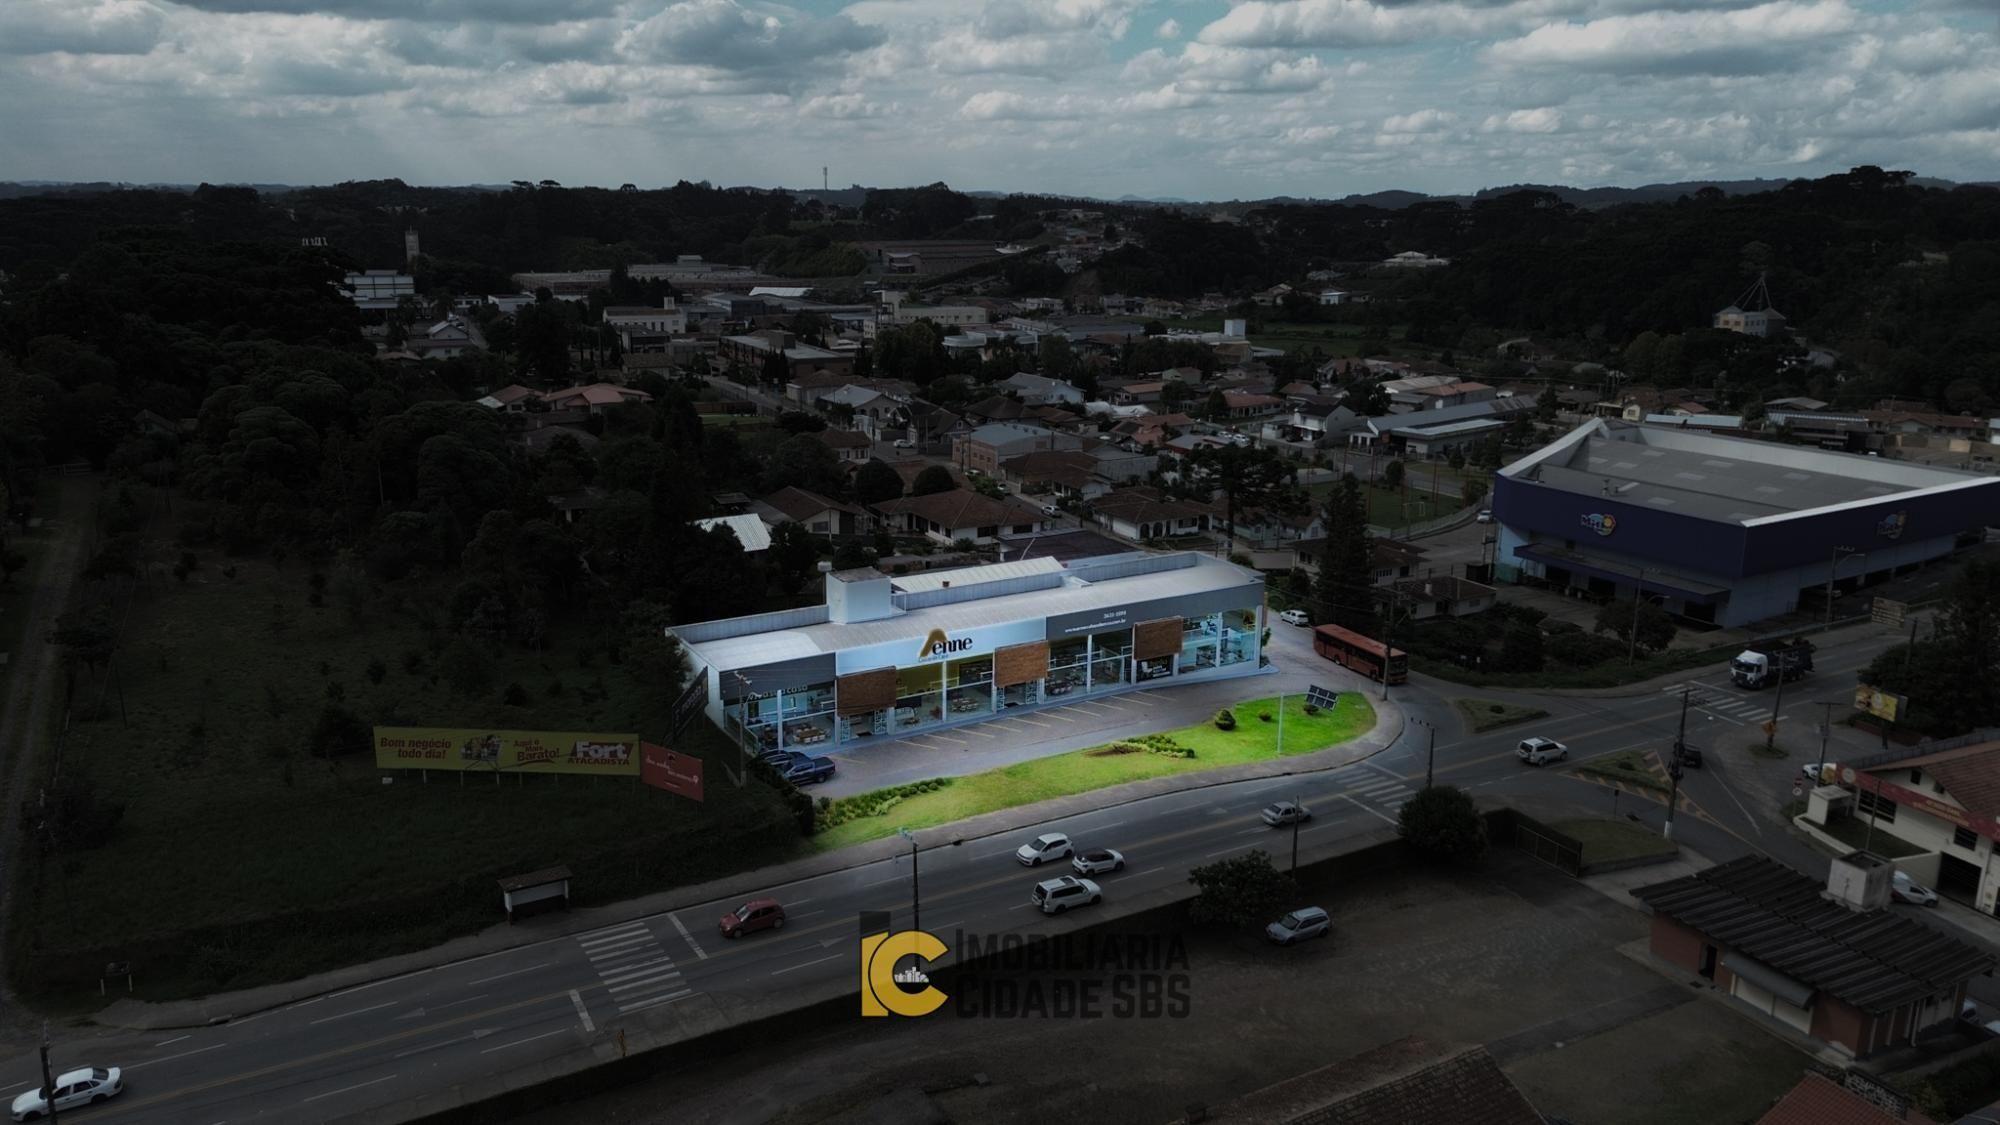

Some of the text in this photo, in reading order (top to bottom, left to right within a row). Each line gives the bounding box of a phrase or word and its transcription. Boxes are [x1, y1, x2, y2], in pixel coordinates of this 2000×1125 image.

[380, 737, 405, 747] Bom
[398, 749, 422, 758] todo
[517, 747, 559, 761] Barato!
[575, 741, 627, 759] Fort
[568, 757, 630, 765] ATACADISTA
